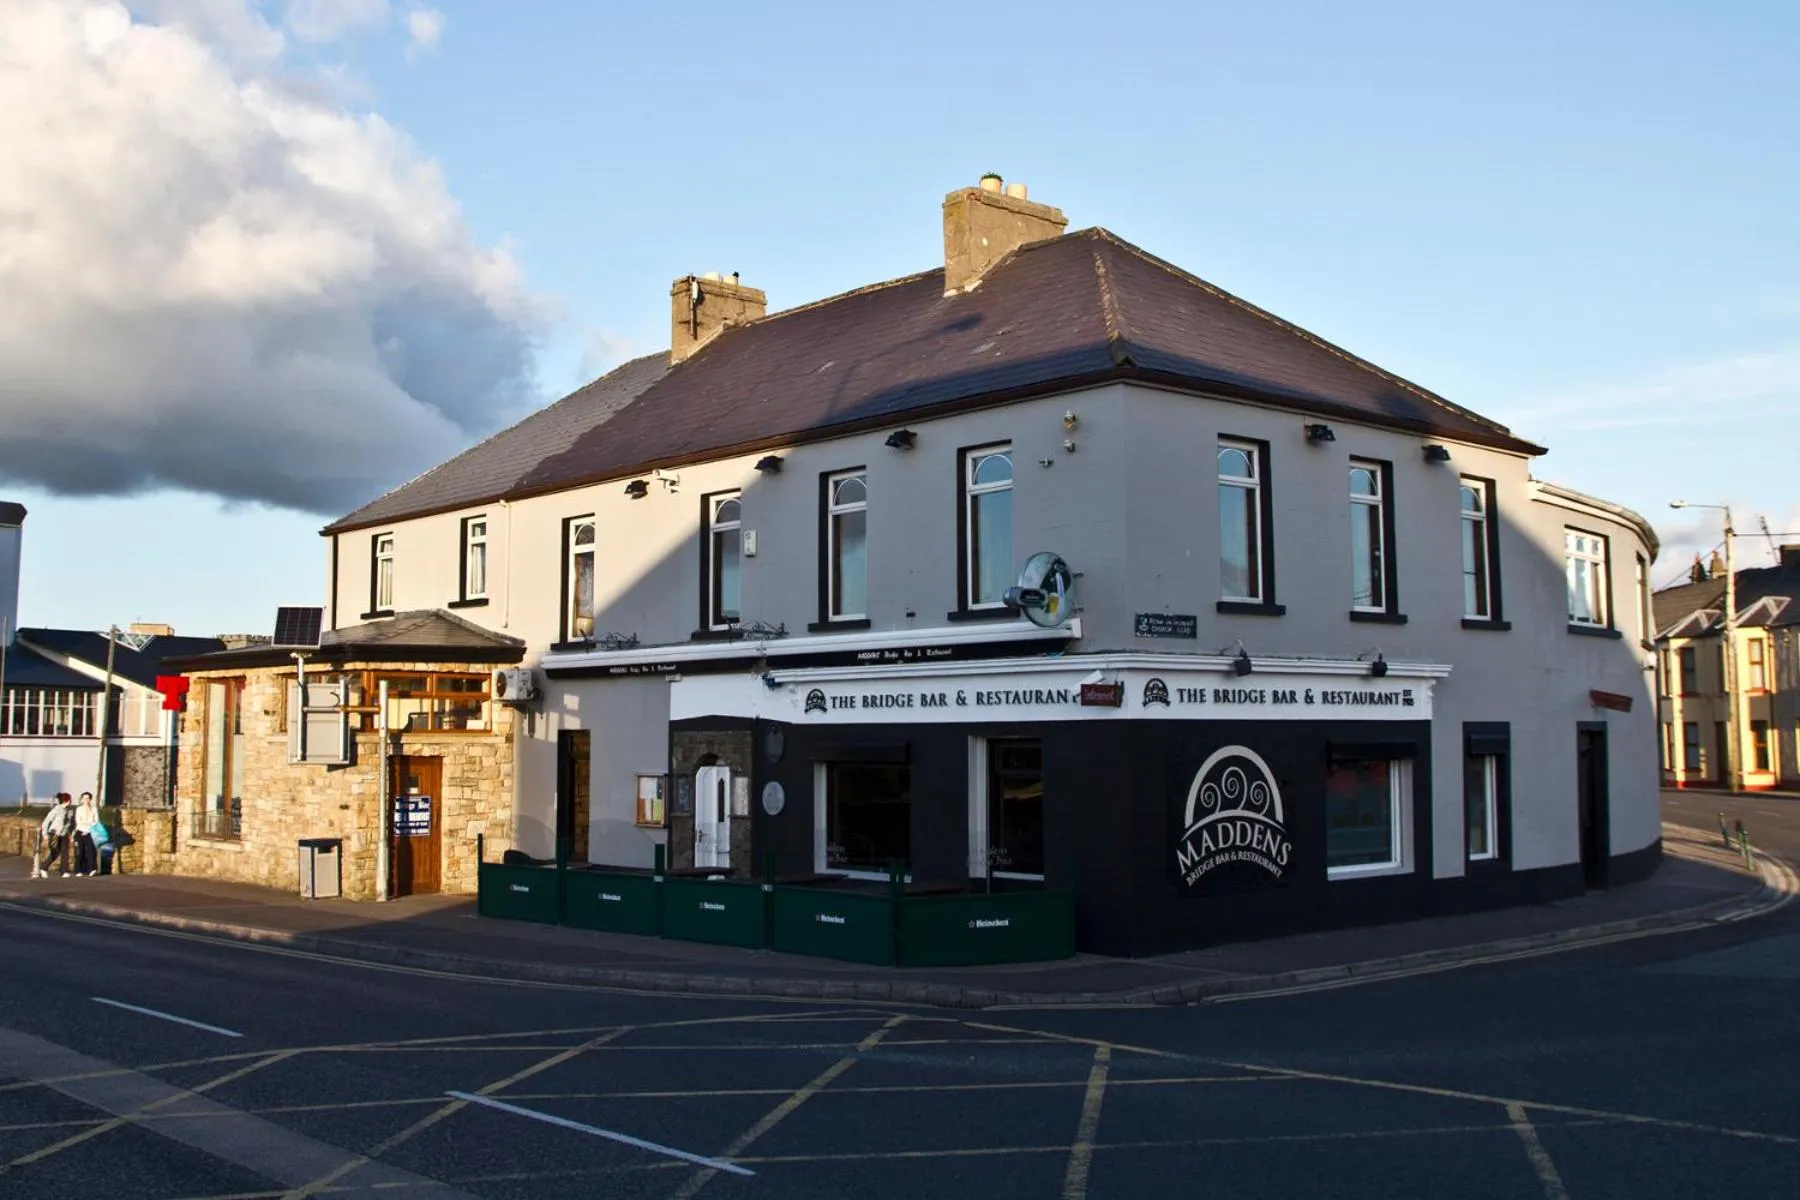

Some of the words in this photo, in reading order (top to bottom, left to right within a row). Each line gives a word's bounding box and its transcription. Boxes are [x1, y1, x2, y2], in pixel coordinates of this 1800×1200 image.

[830, 695, 856, 709] THE
[862, 692, 914, 708] BRIDGE
[920, 692, 948, 707] BAR
[956, 689, 968, 706] &
[1176, 688, 1207, 703] THE
[1213, 688, 1266, 704] BRIDGE
[1272, 689, 1298, 704] BAR
[1304, 688, 1315, 705] &
[1321, 690, 1401, 706] RESTAURANT
[1176, 820, 1292, 876] MADDENS
[1185, 857, 1216, 888] BRIDGE
[1214, 851, 1231, 865] BAR
[1230, 851, 1238, 861] &
[1237, 850, 1283, 879] RESTAURANT
